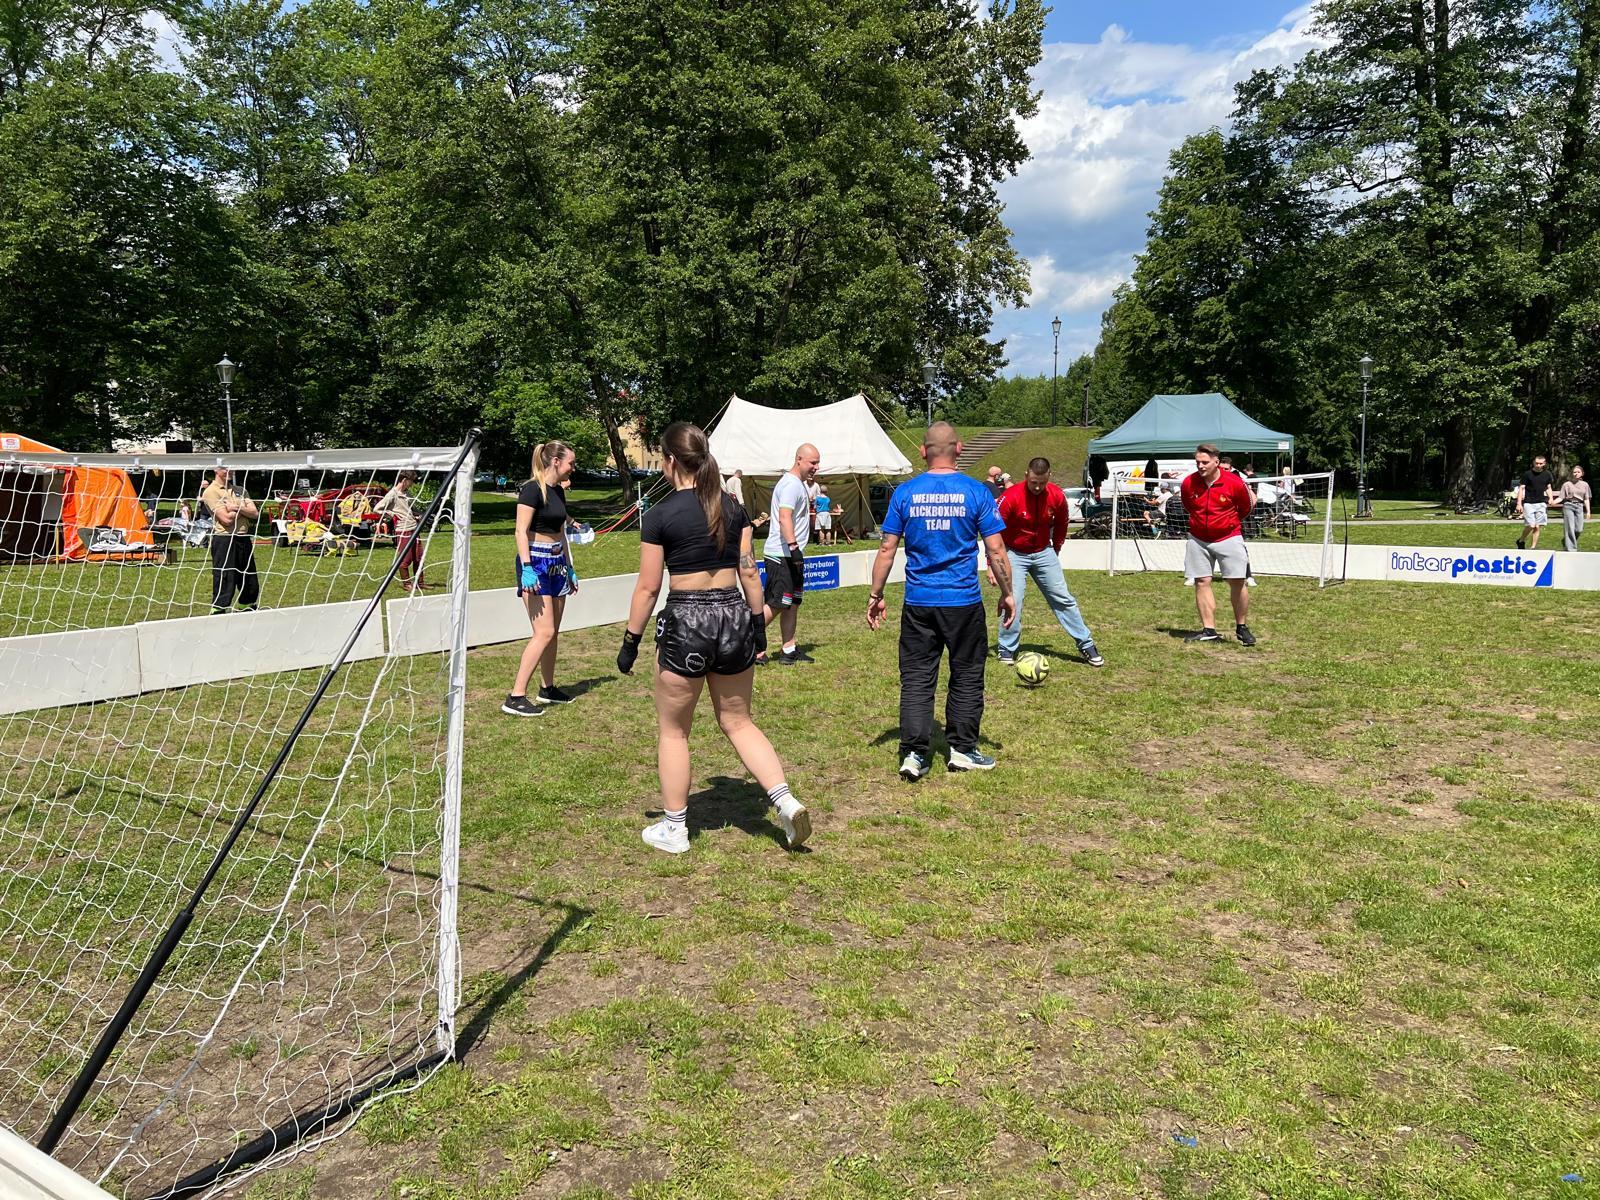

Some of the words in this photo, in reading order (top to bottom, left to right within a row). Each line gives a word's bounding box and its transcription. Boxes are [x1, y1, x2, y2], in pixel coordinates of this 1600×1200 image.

[912, 493, 965, 504] WEJHEROWO
[909, 506, 966, 518] KICKBOXING
[925, 519, 951, 531] TEAM
[803, 560, 835, 571] ystrybutor
[1391, 552, 1537, 578] interplastic
